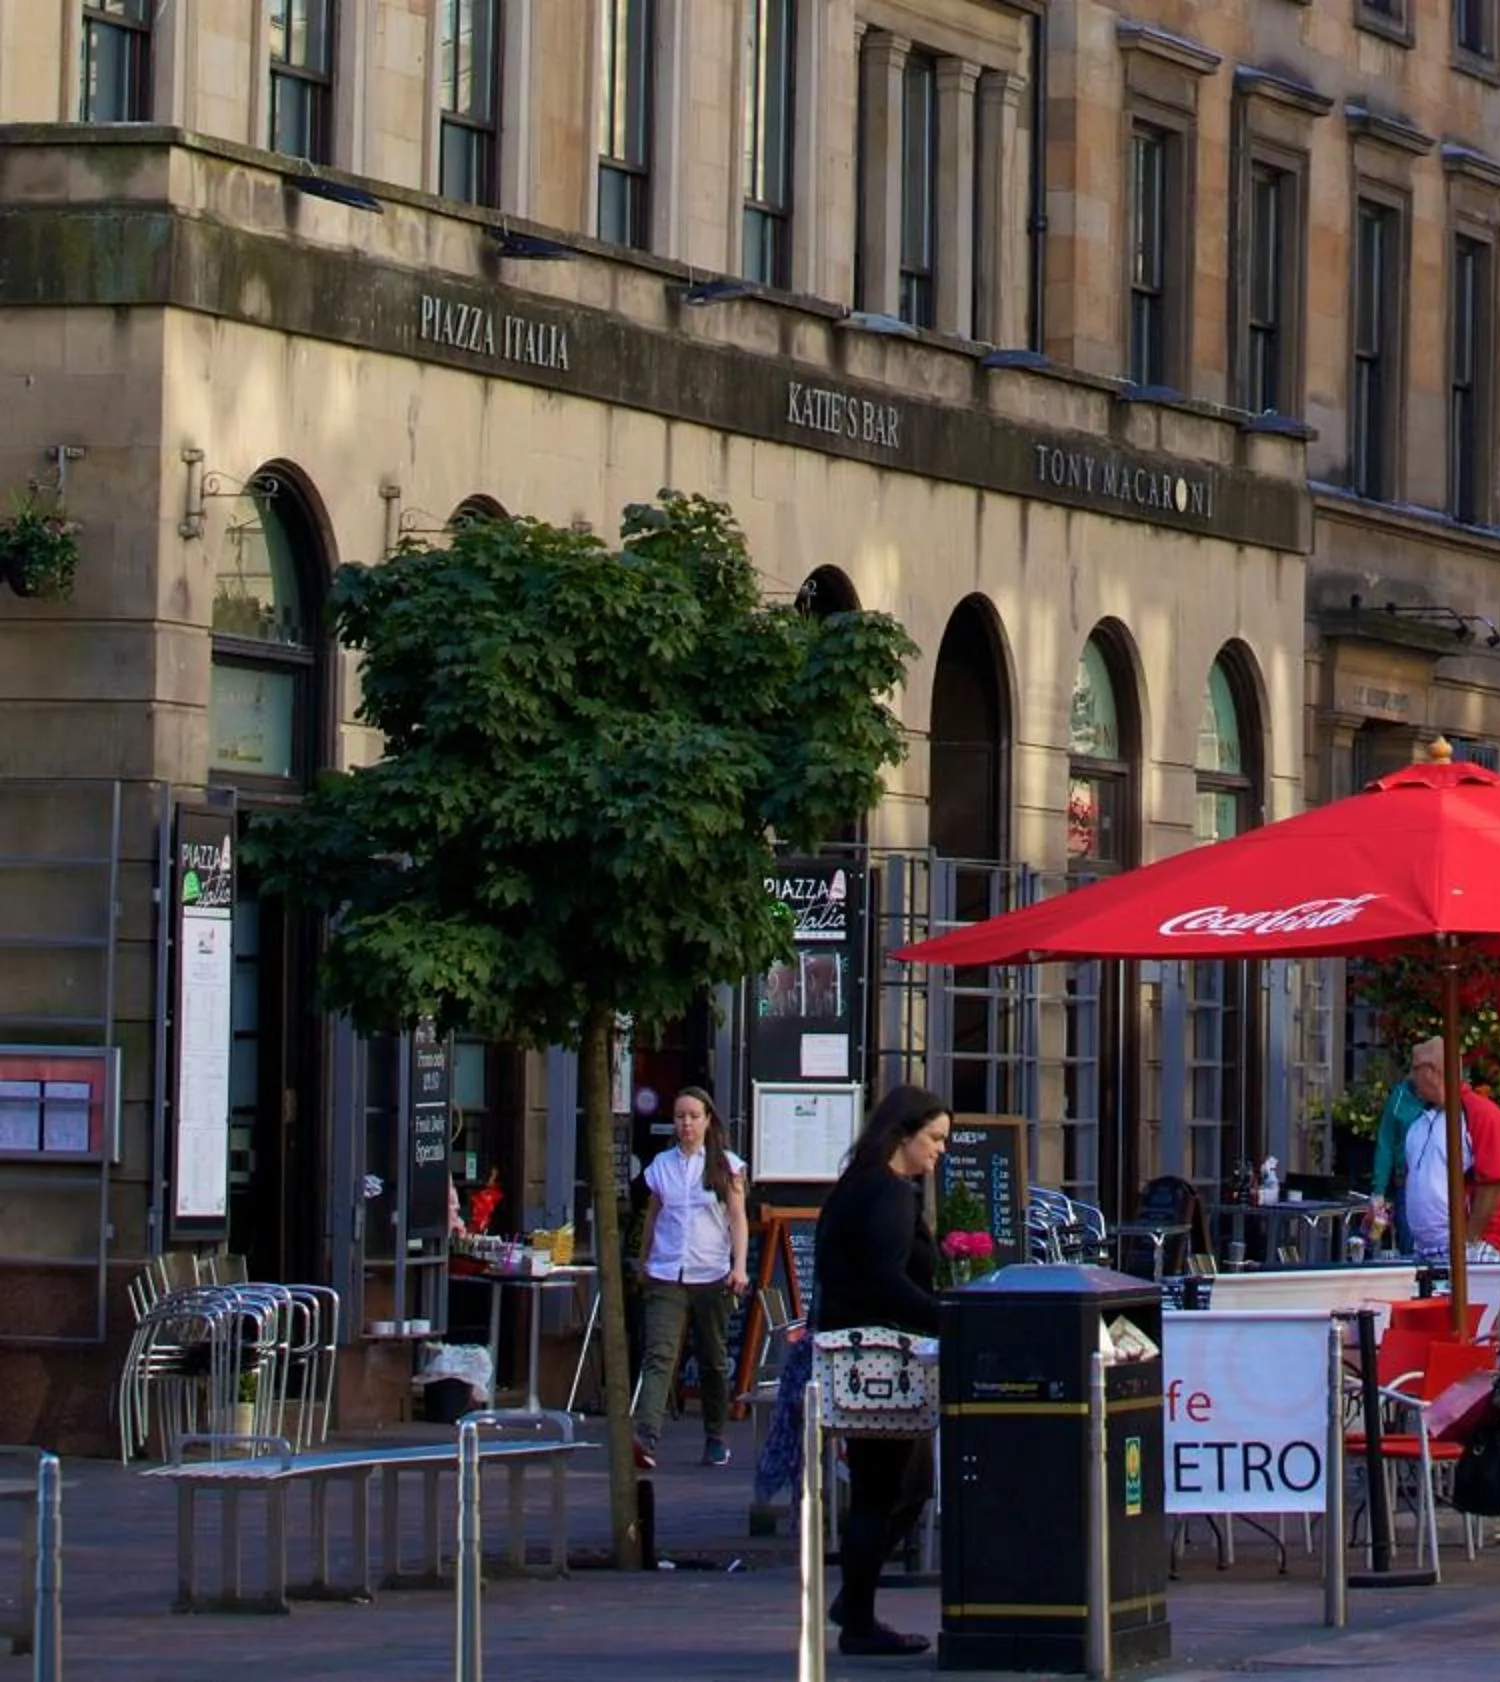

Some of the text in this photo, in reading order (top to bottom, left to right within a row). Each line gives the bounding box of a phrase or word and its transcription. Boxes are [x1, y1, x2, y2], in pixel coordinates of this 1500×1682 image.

[421, 294, 570, 371] PIAZZA ITALIA
[786, 381, 900, 449] KATIE'S BAR
[1036, 443, 1214, 519] TONY MACARONI
[181, 843, 221, 869] PIAZZA
[763, 878, 830, 899] PIAZZA
[1158, 893, 1389, 936] Coca-Cola
[1165, 1379, 1212, 1422] fe
[1172, 1440, 1322, 1493] ETRO
